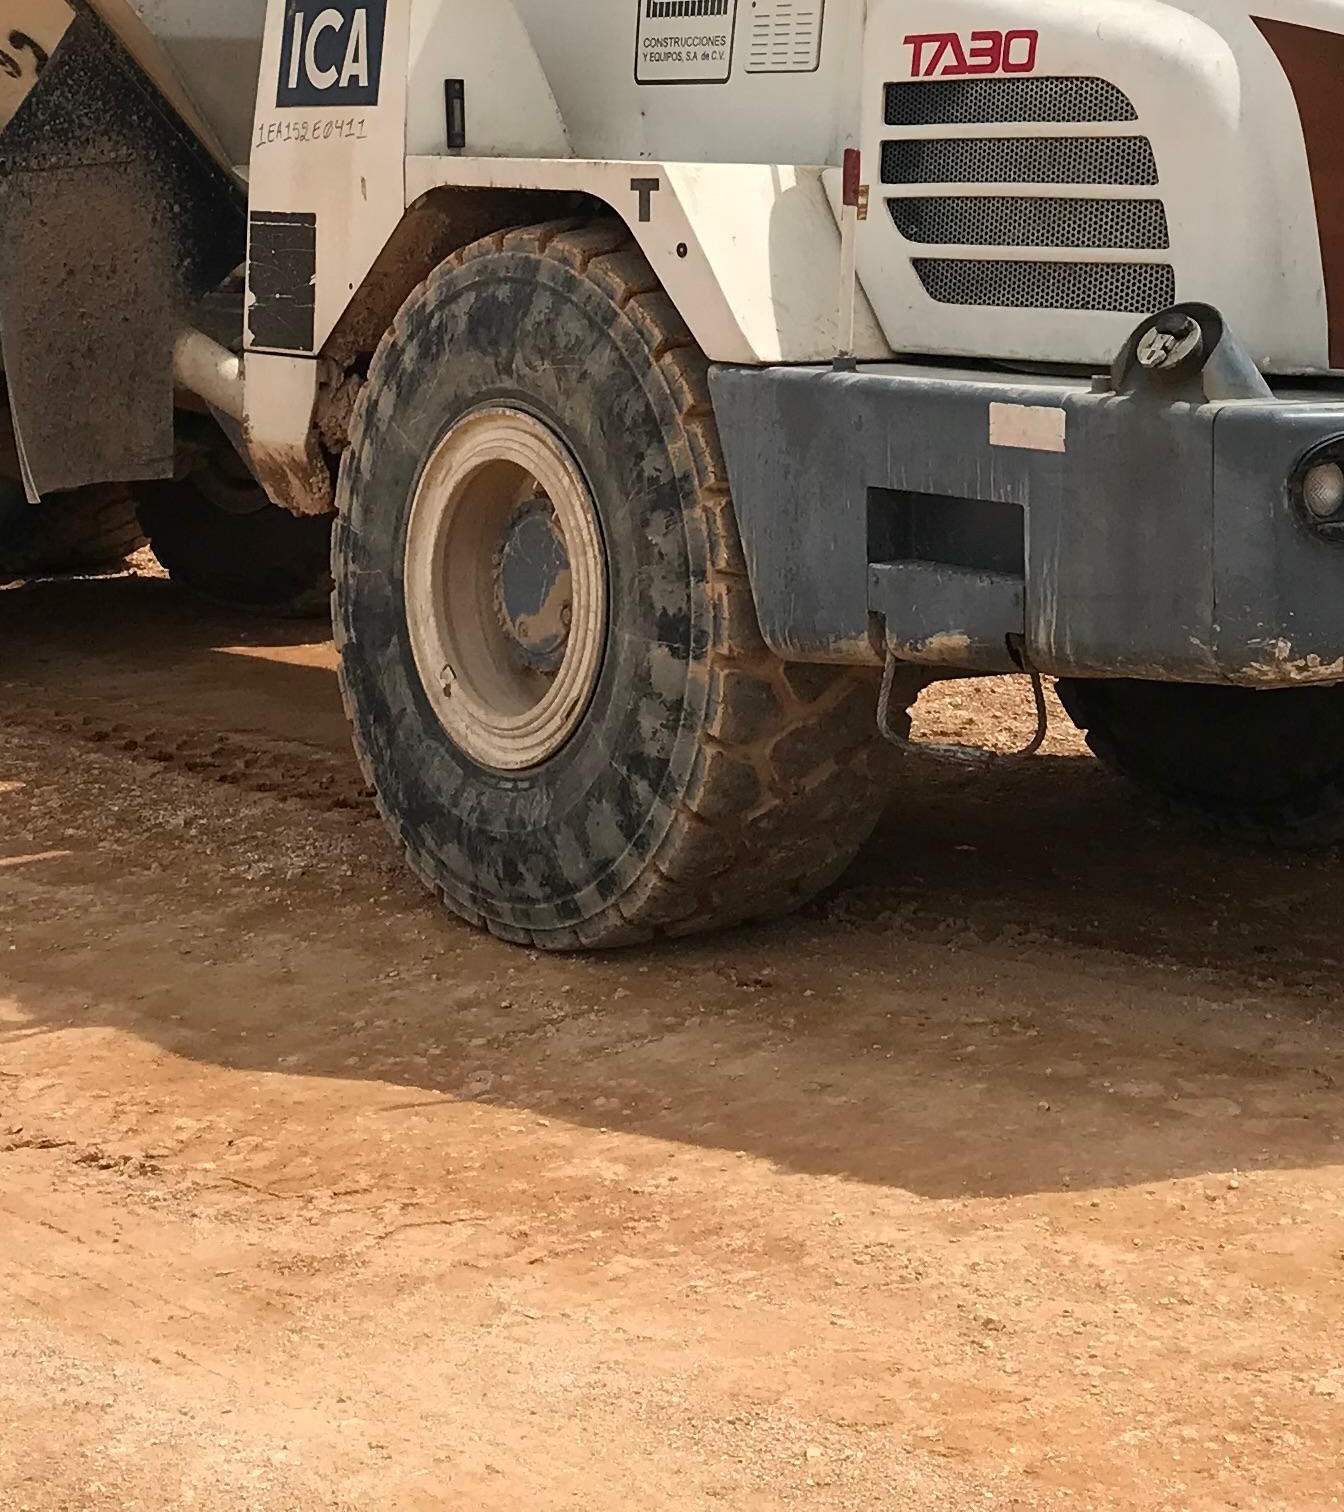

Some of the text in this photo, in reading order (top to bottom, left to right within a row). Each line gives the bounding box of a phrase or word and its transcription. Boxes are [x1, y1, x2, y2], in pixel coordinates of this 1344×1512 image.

[288, 8, 369, 90] ICA
[643, 35, 726, 48] CONSTRUCCIONES
[643, 52, 648, 62] Y
[701, 51, 709, 60] de
[903, 29, 1039, 78] TA30
[630, 177, 660, 223] T
